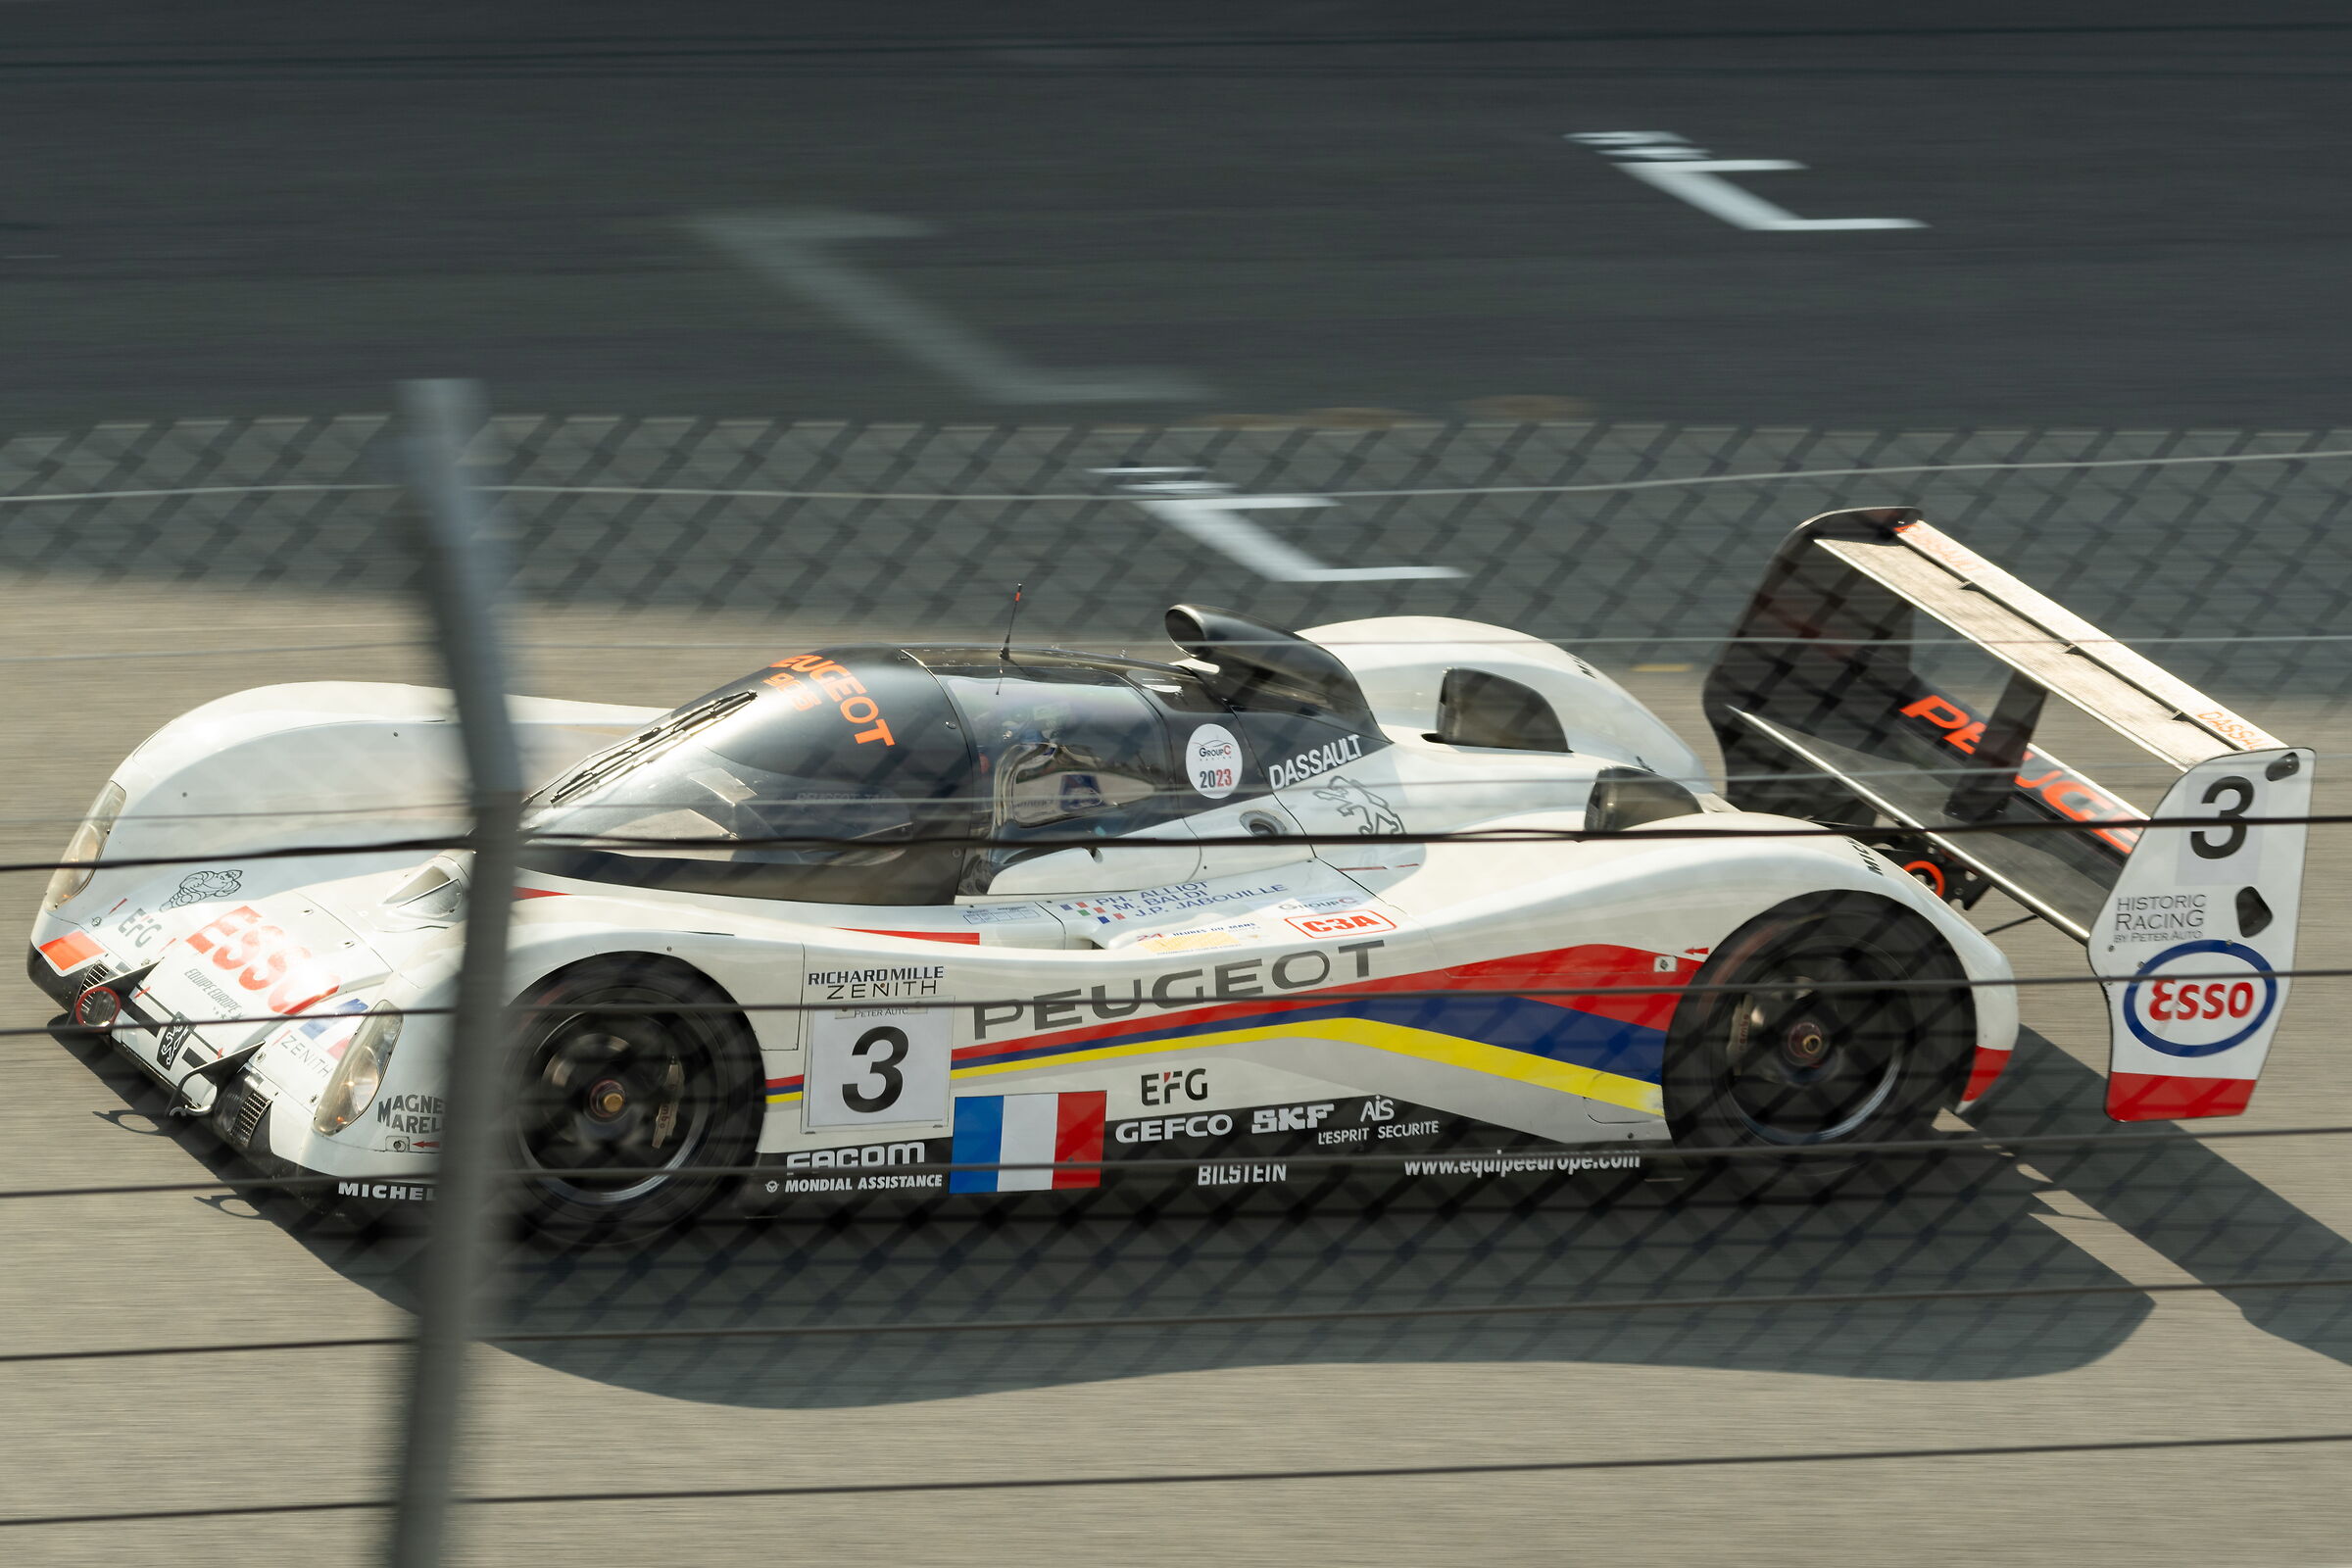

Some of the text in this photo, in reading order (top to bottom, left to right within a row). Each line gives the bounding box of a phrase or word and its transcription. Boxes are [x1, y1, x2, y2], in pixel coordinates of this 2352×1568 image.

[1268, 734, 1363, 791] DASSAULT
[1200, 768, 1233, 789] 2023
[2190, 775, 2255, 859] 3
[1095, 881, 1208, 906] PH. ALLIOT
[1112, 890, 1209, 911] M. BALDI
[1134, 884, 1288, 917] J.P. JABOUILLE
[2117, 894, 2206, 911] HISTORIC
[118, 907, 163, 949] EFG
[1302, 915, 1381, 933] C3A
[2115, 909, 2204, 931] RACING
[2131, 932, 2170, 943] PETER
[2173, 930, 2203, 941] AUTO
[826, 979, 937, 1001] ZENITH
[973, 940, 1385, 1041] PEUGEOT
[280, 1034, 333, 1078] ZENITH
[841, 1025, 910, 1114] 3
[1141, 1068, 1208, 1106] EFG
[1115, 1102, 1335, 1144] GEFCO SKF
[1318, 1120, 1440, 1146] L'ESPRIT SECURITE
[786, 1142, 926, 1176] FACOM
[784, 1174, 943, 1193] MONDIAL ASSISTANCE
[1198, 1163, 1288, 1187] BILSTEIN
[337, 1181, 440, 1201] MICHEL
